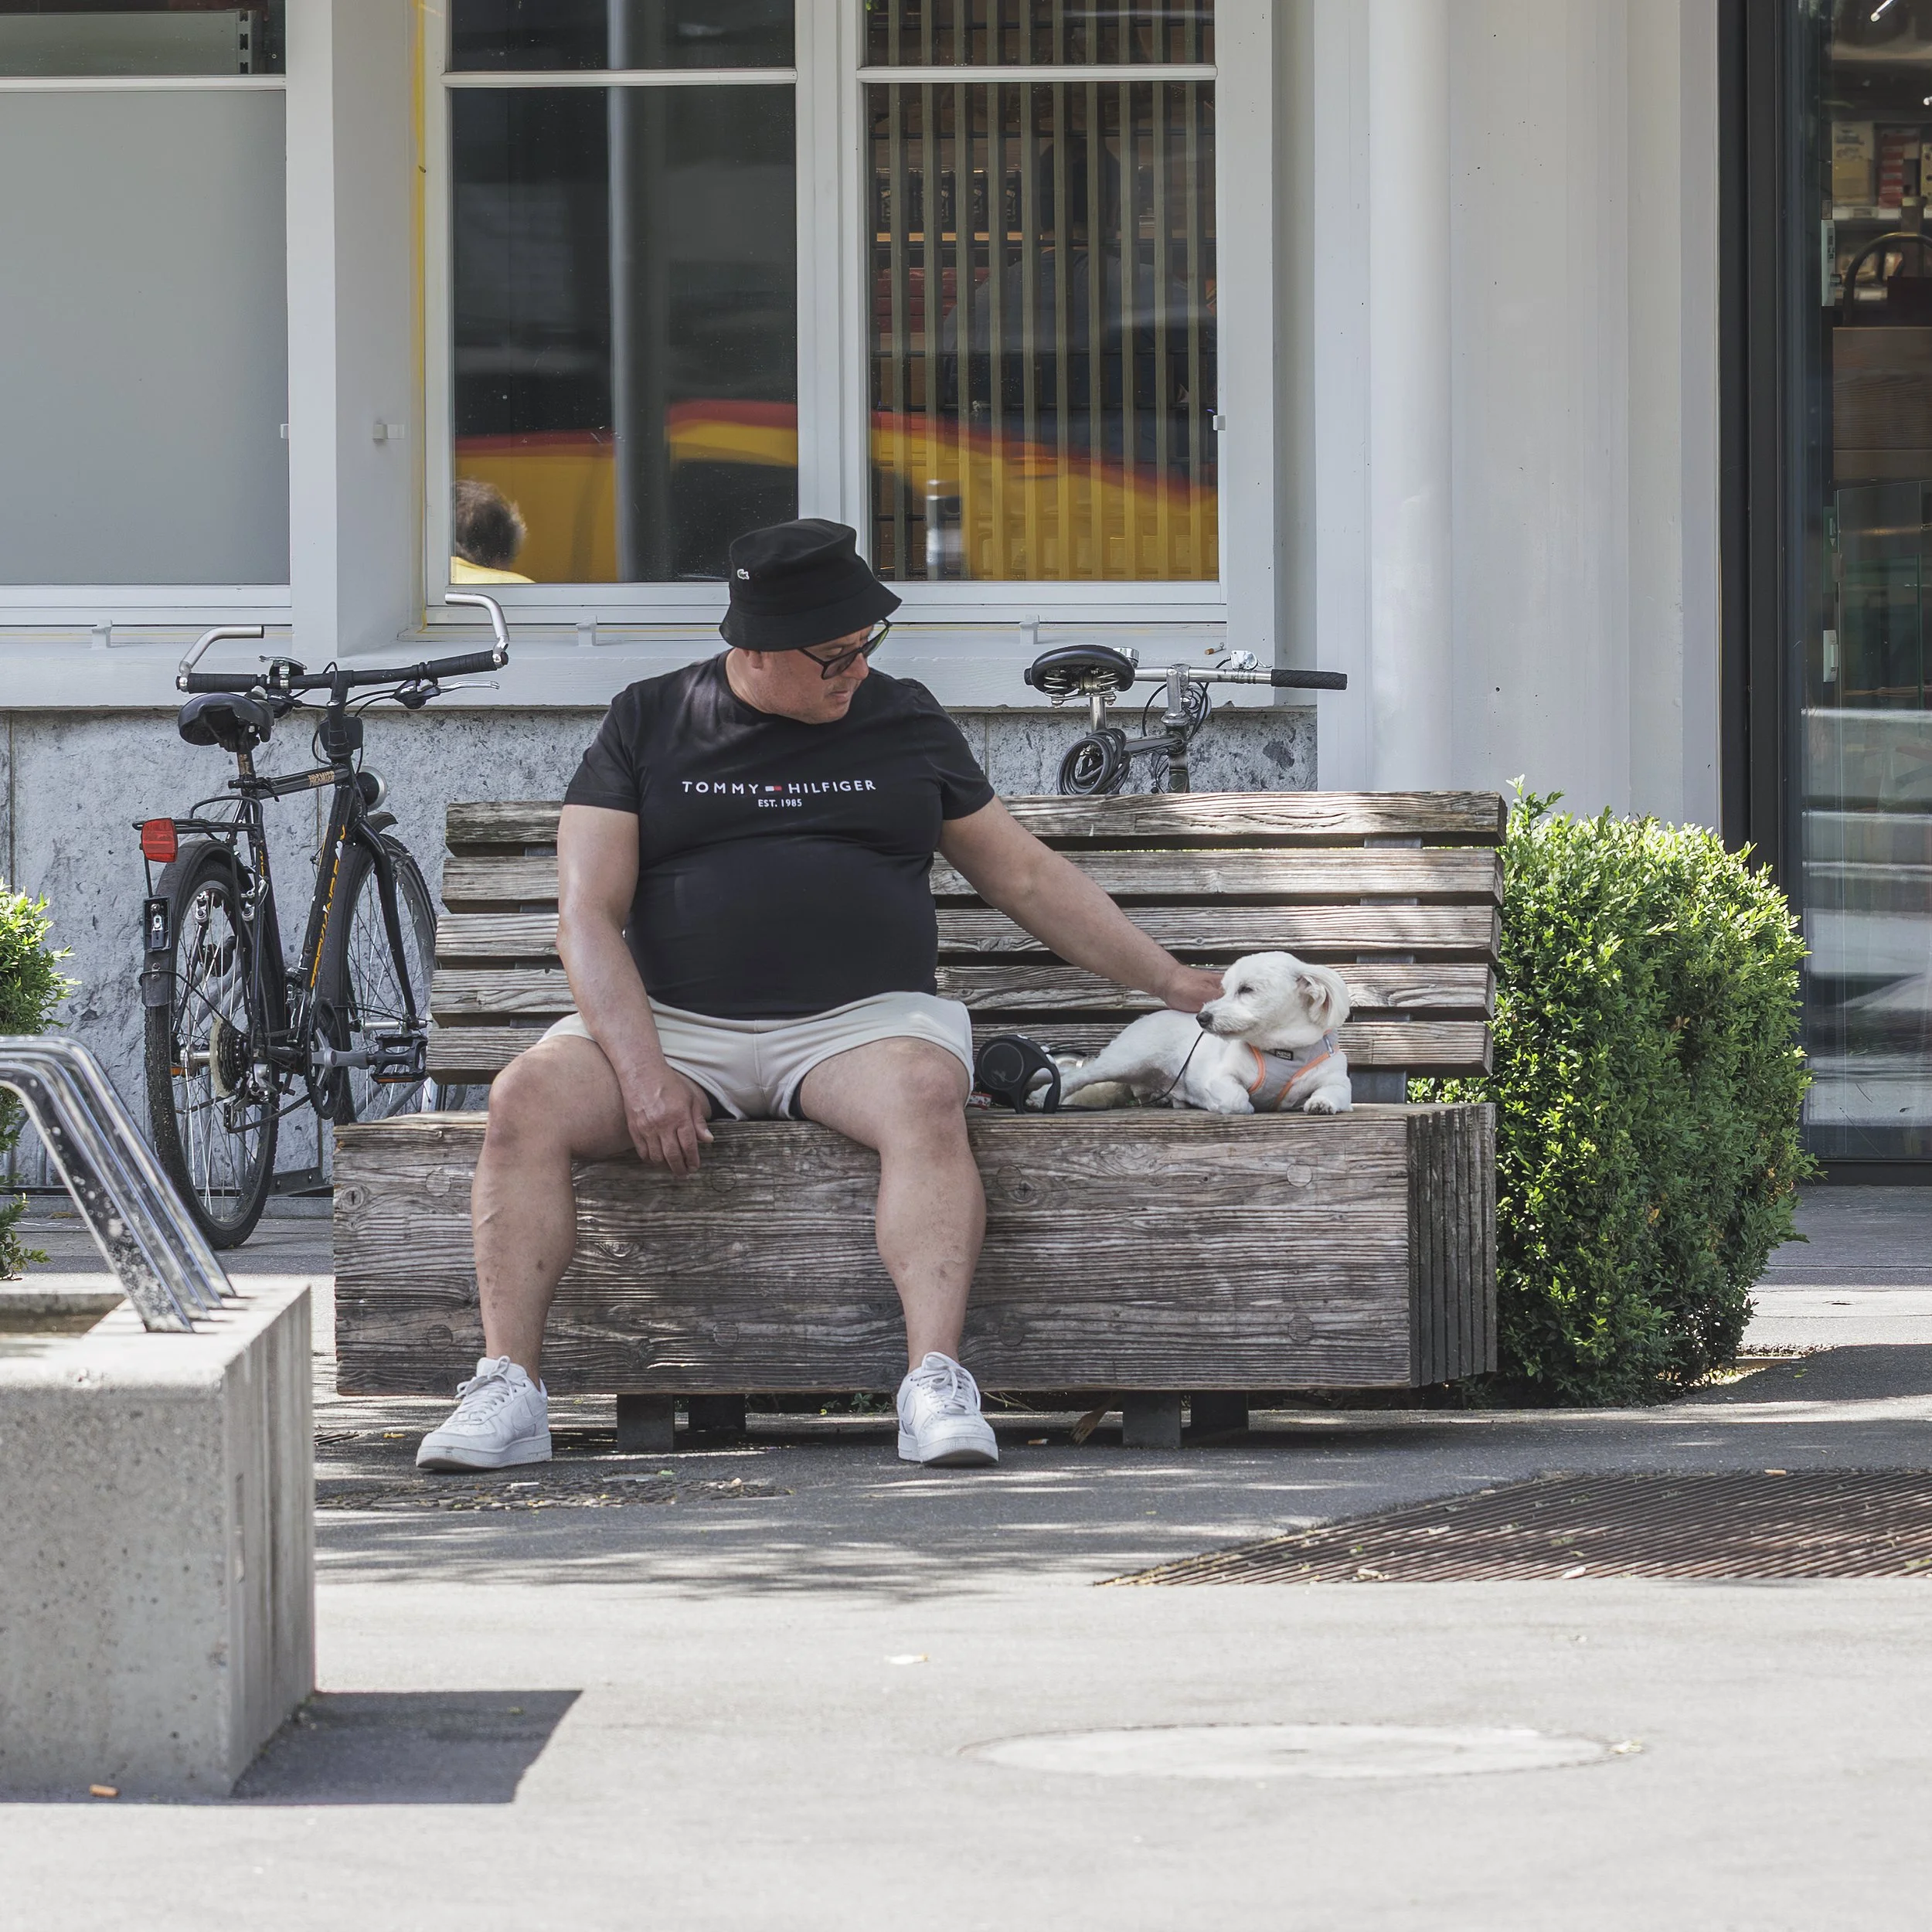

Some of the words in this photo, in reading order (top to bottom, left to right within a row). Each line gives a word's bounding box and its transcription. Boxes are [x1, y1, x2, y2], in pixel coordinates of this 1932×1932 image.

[682, 781, 759, 794] TOMMY
[787, 779, 876, 794] HILFIGER
[757, 798, 777, 808] EST.
[781, 798, 803, 808] 1985
